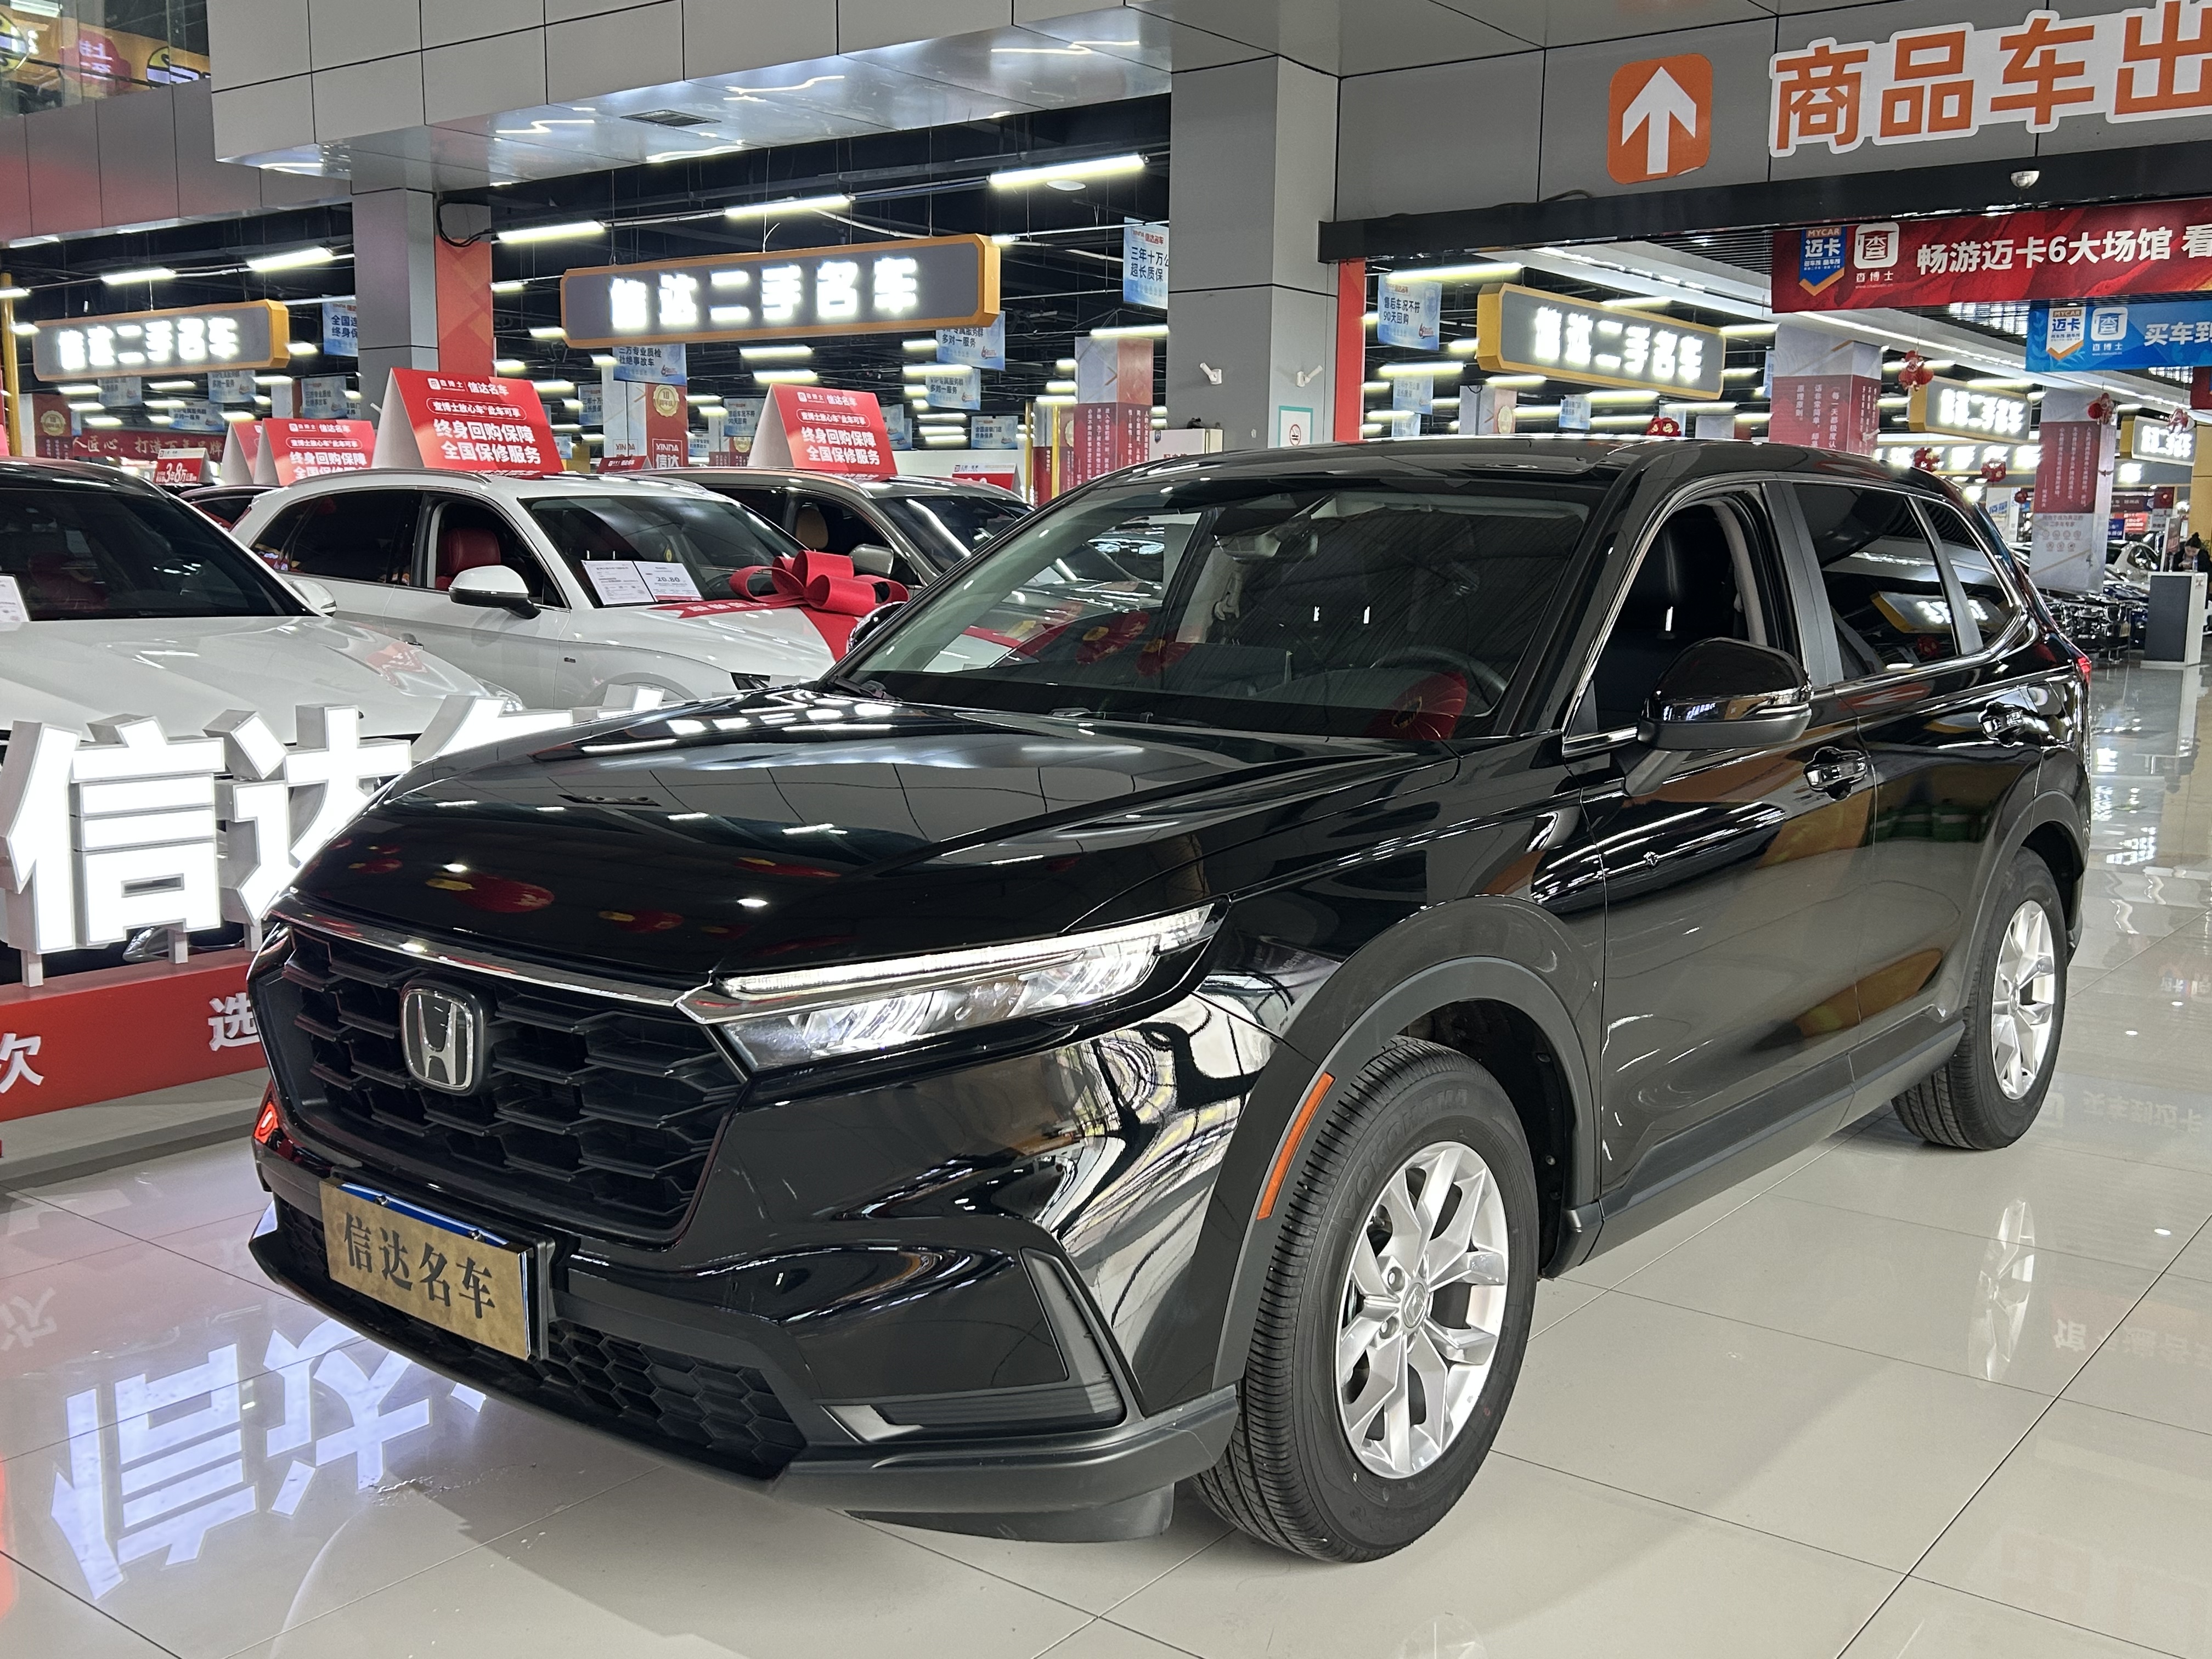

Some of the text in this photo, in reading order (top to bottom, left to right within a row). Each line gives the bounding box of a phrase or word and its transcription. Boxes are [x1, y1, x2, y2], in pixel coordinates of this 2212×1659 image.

[1775, 1, 2212, 151] 商品车出
[1807, 228, 1840, 237] MYCAR
[1805, 238, 1841, 258] 迈卡
[1917, 224, 2212, 275] 畅游迈卡6大场馆 看
[1130, 262, 1163, 283] 超长质保
[1855, 270, 1894, 283] 查博士
[1384, 296, 1420, 314] 售后车况不符
[1384, 312, 1409, 325] 90天回购
[2052, 318, 2080, 332] 迈卡
[942, 334, 976, 348] 多对一服务
[2143, 321, 2212, 347] 买车到
[619, 357, 655, 367] 杜绝事故车
[467, 382, 510, 396] 信达名车
[433, 419, 536, 444] 终身回购保障
[802, 426, 877, 448] 终身回购保障
[441, 441, 541, 465] 全国保修服务
[656, 443, 679, 452] XINDA
[806, 445, 880, 465] 全国保修服务
[289, 451, 368, 466] 终身回购保障
[343, 1211, 495, 1319] 信达名车
